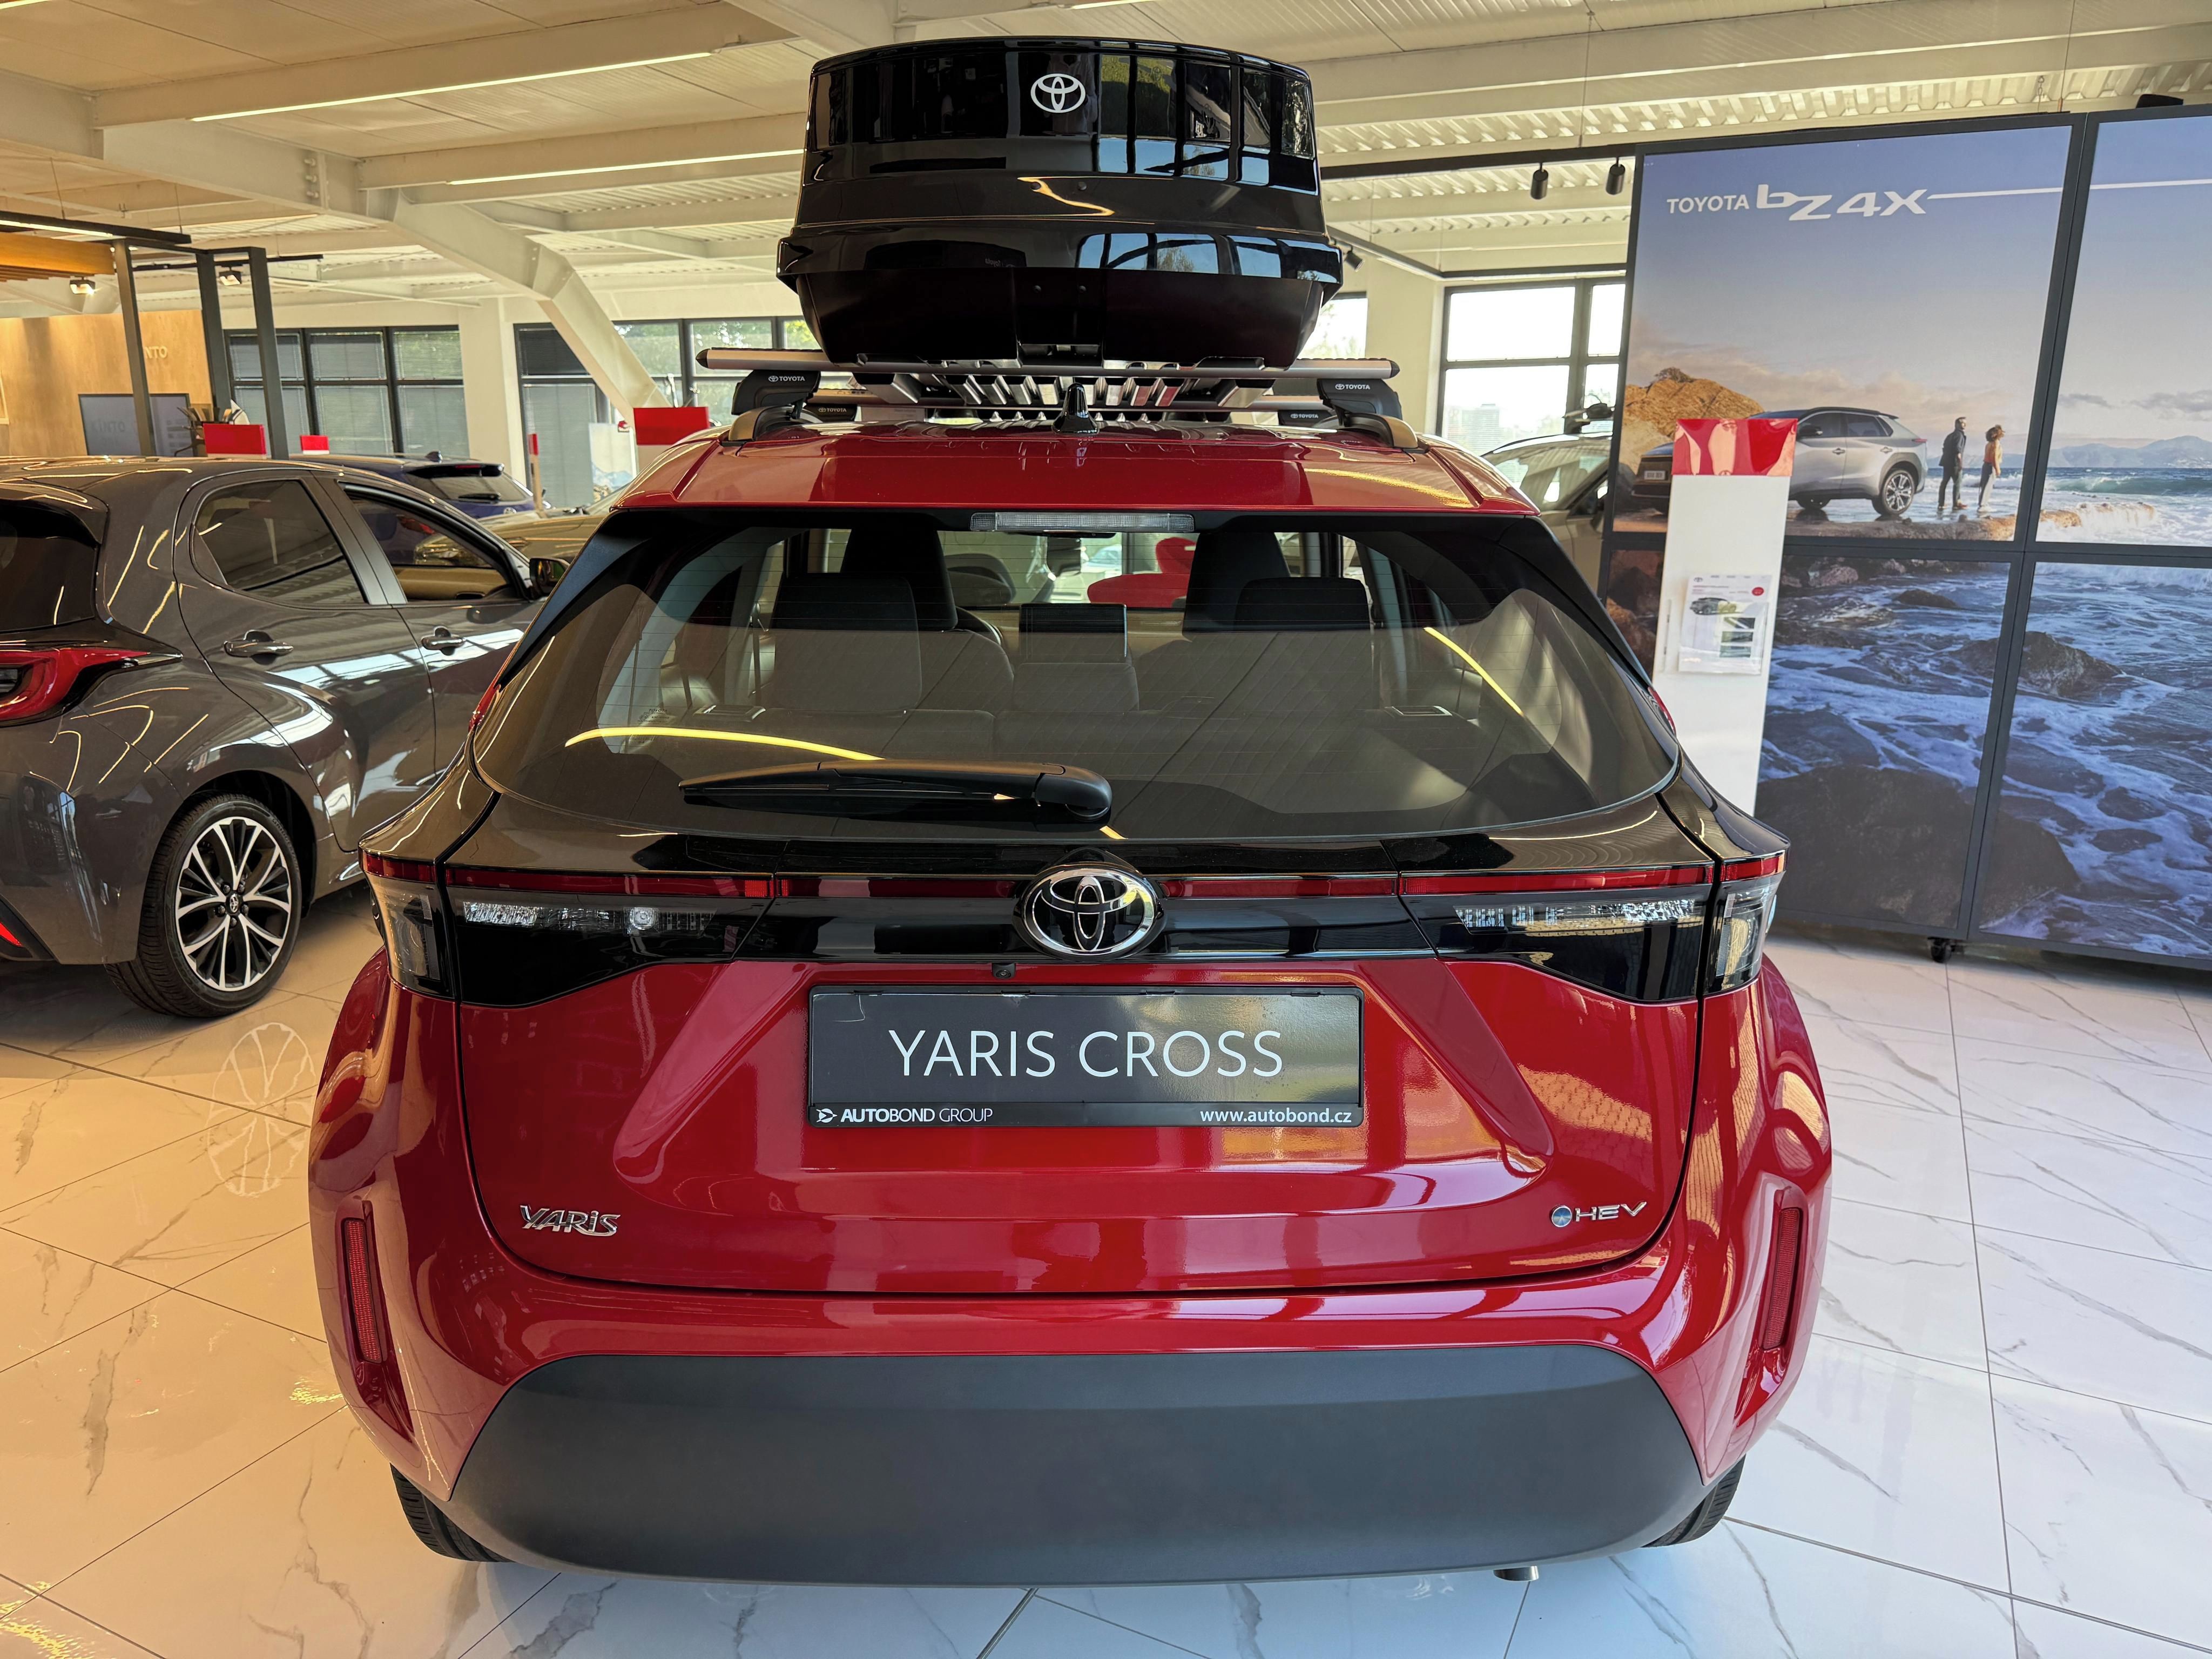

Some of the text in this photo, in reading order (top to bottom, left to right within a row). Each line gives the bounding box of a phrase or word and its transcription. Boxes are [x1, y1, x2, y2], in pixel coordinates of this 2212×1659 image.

[1667, 194, 1750, 214] TOYOTA
[888, 1030, 1283, 1077] YARIS CROSS
[840, 1108, 993, 1123] AUTOBOND GROUP
[1199, 1107, 1352, 1124] www.autobond.cz
[520, 1204, 621, 1237] YARIS
[1575, 1201, 1647, 1222] HEV
